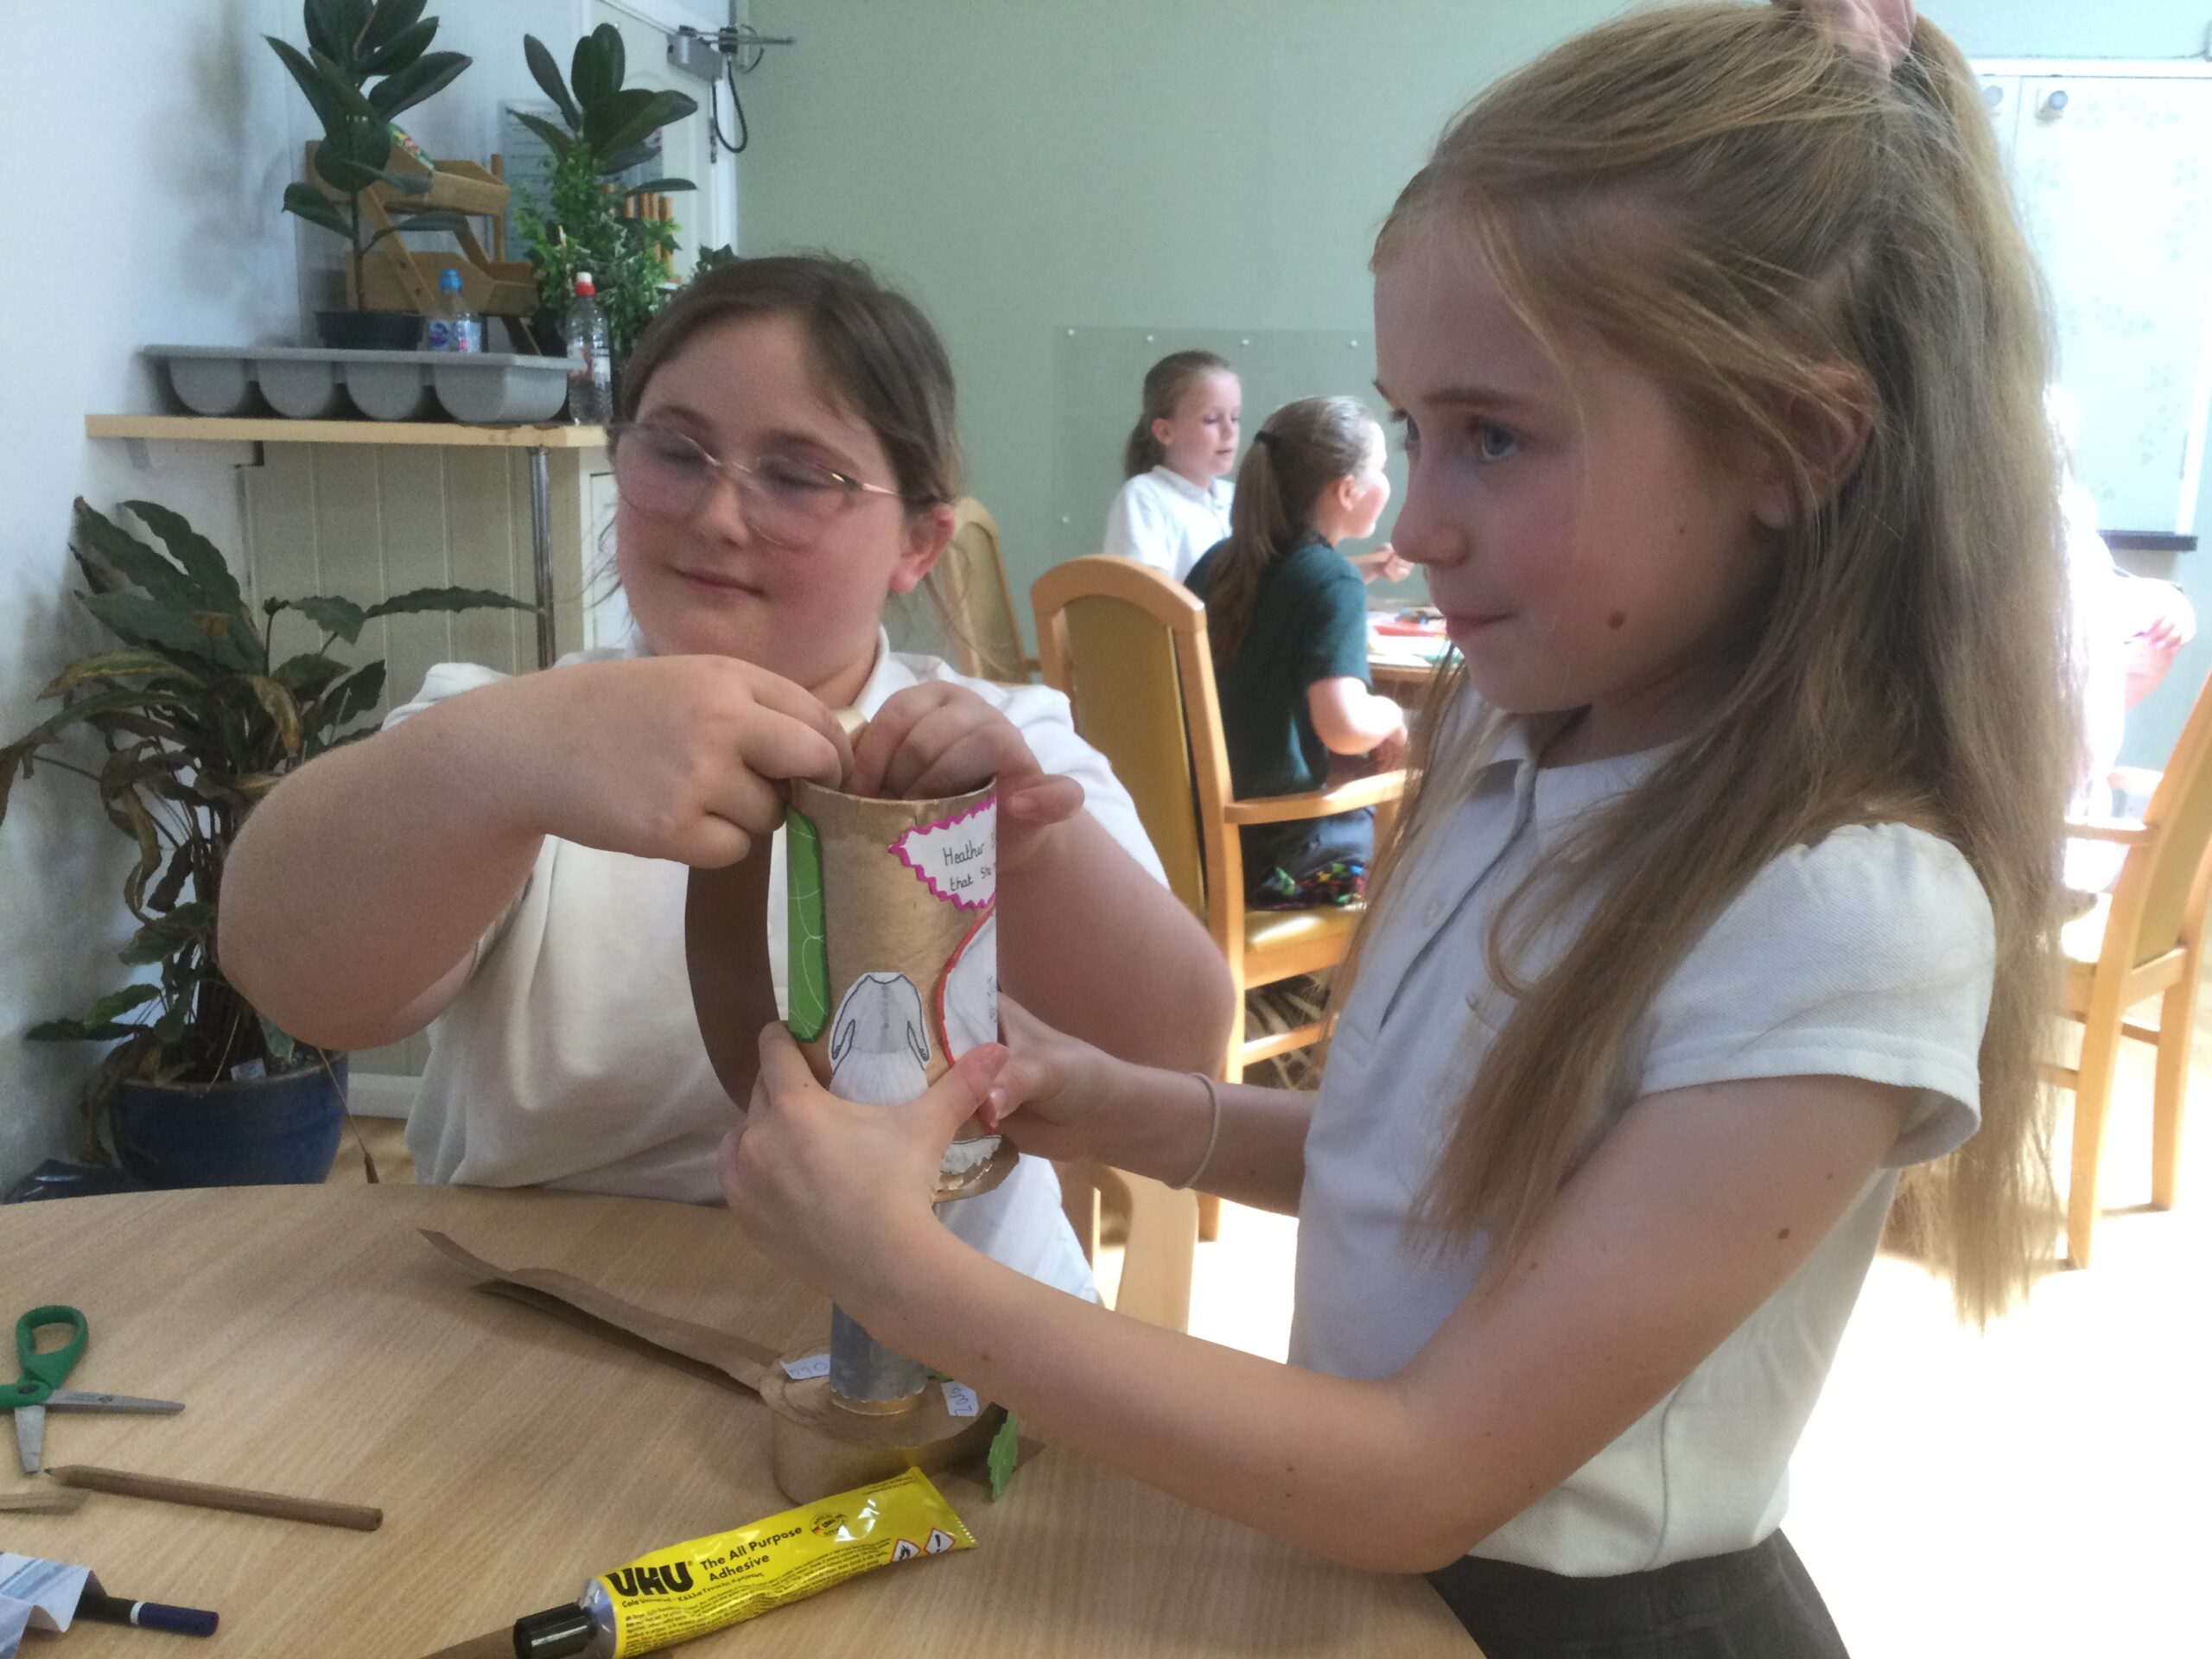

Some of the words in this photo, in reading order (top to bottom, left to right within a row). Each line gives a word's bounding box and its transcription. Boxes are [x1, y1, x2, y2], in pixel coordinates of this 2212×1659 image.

[950, 873, 974, 892] that
[700, 1556, 726, 1571] The
[728, 1545, 747, 1561] All
[748, 1526, 803, 1556] Purpose
[604, 1560, 694, 1598] UHU
[709, 1554, 771, 1582] Adhesive
